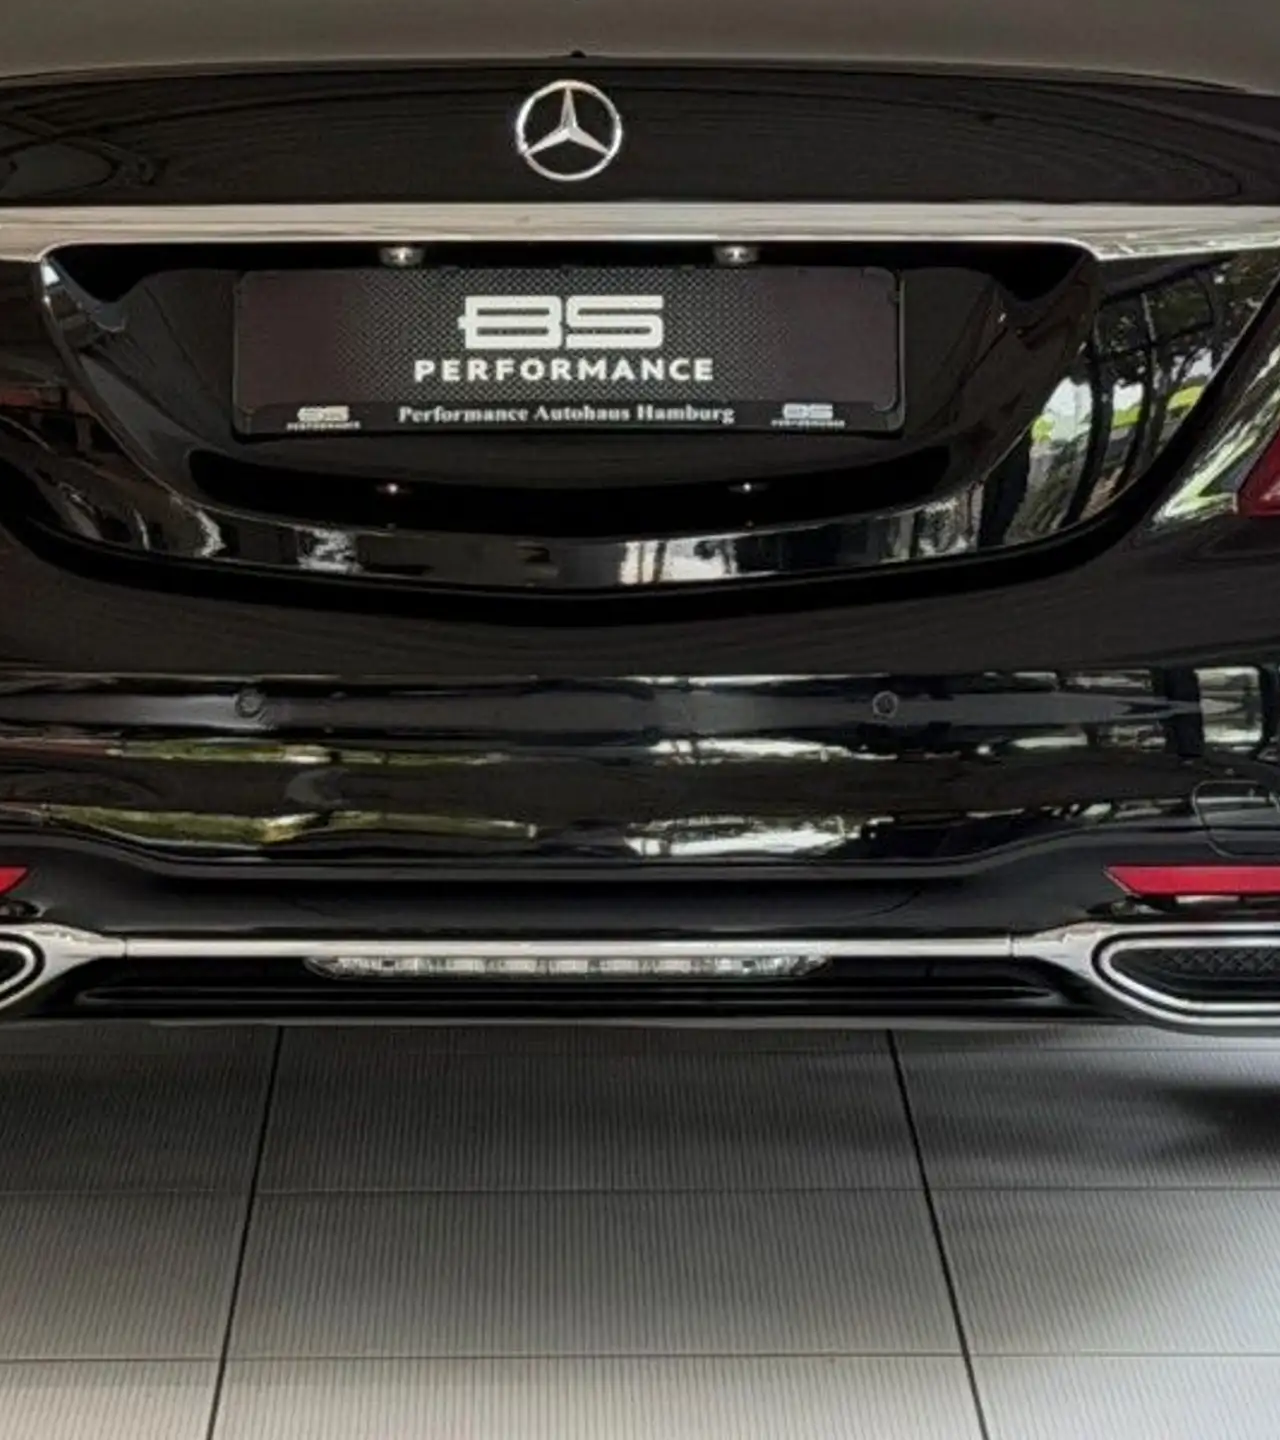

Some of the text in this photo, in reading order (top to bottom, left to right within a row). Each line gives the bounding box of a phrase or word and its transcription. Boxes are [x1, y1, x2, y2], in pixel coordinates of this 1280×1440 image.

[458, 293, 665, 350] BS
[413, 358, 714, 383] PERFORMANCE
[398, 403, 735, 426] Performance Autohaus Hamburg
